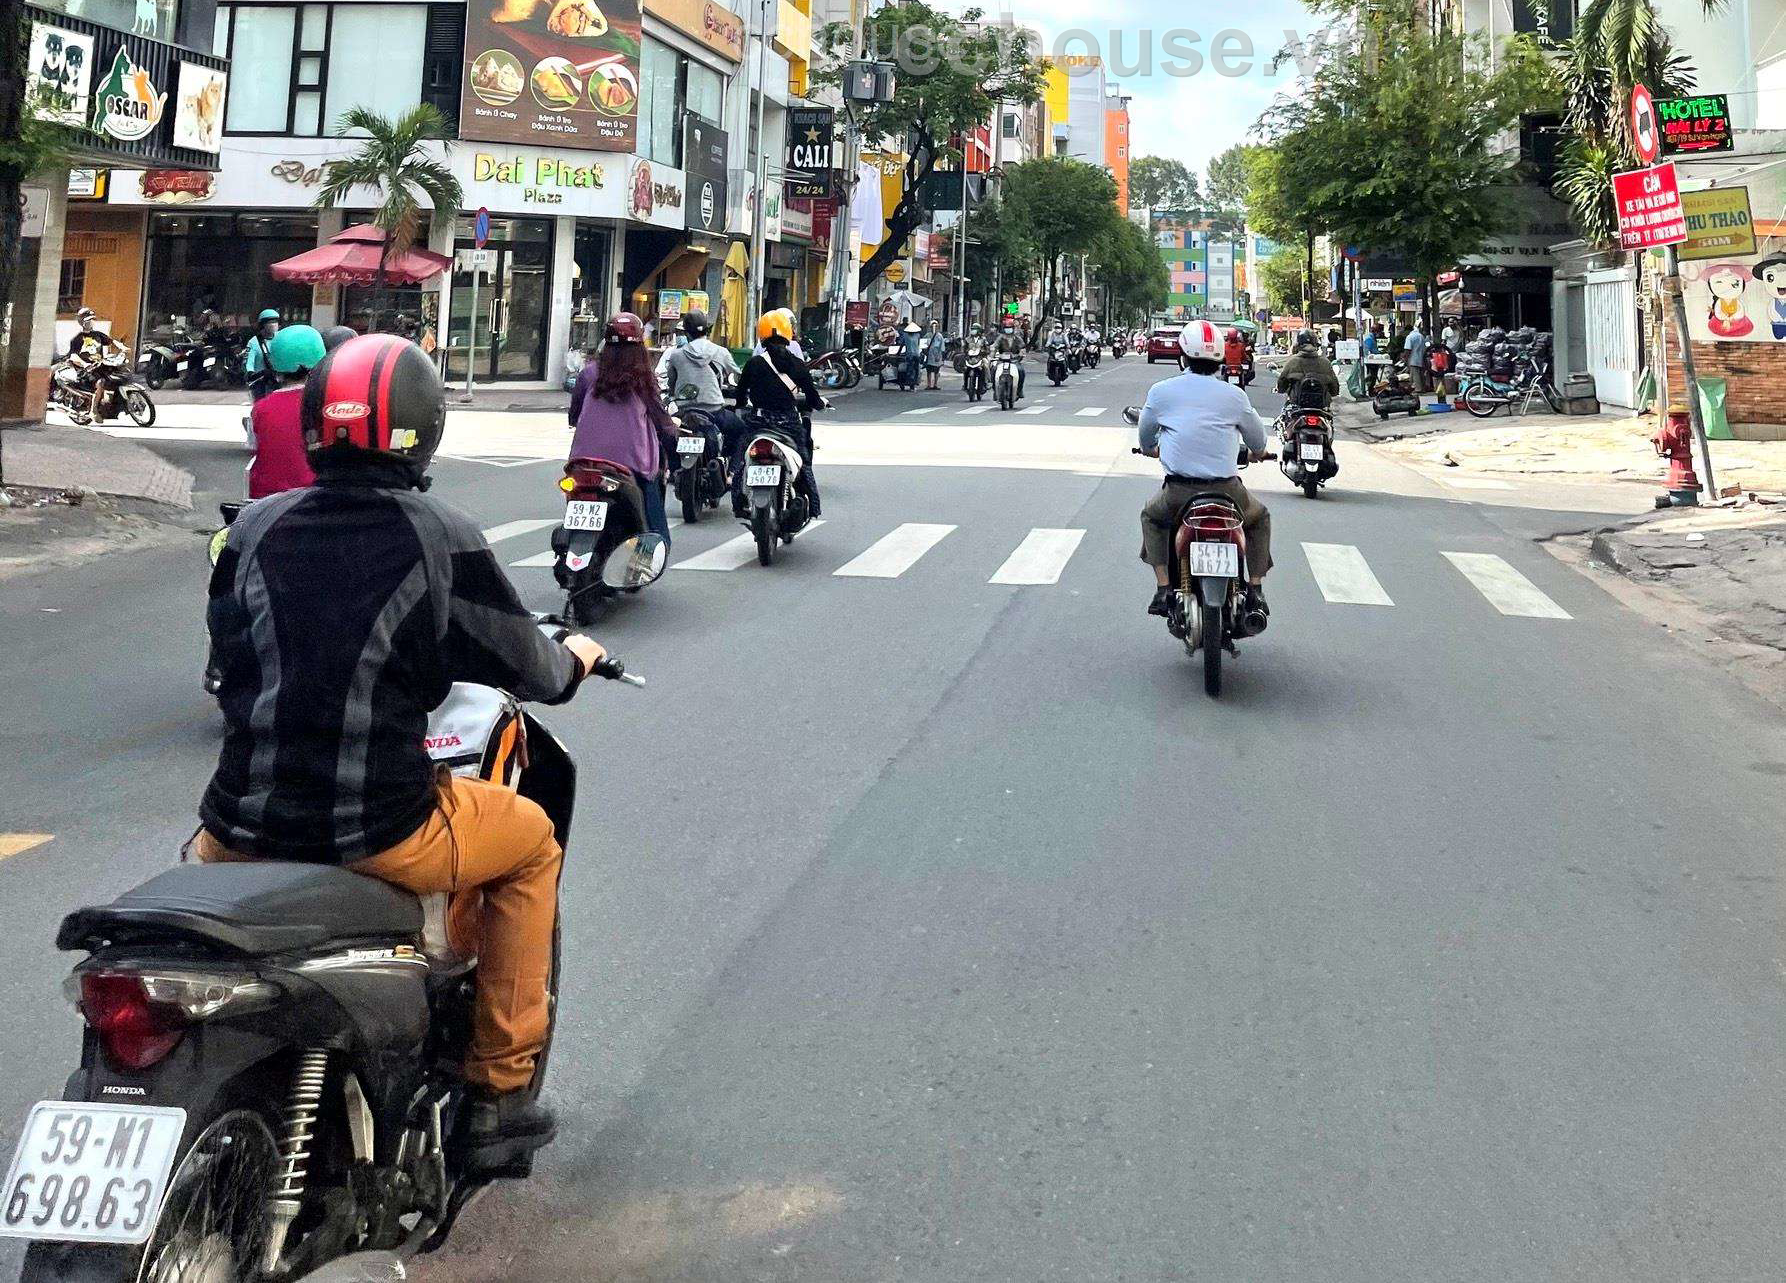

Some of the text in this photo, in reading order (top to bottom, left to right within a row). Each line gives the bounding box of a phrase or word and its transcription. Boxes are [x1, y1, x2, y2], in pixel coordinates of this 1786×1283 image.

[105, 96, 149, 120] OSCAR
[1661, 98, 1723, 120] HOTEL
[793, 144, 830, 168] CALI
[474, 153, 605, 189] Dai Phat
[883, 160, 901, 177] ĐẸP
[523, 189, 563, 204] Plaza
[795, 185, 824, 195] 24/24
[1685, 213, 1707, 231] HU
[1709, 206, 1748, 229] THẢO
[102, 1085, 146, 1095] HONDA
[5, 1172, 153, 1231] 698.63
